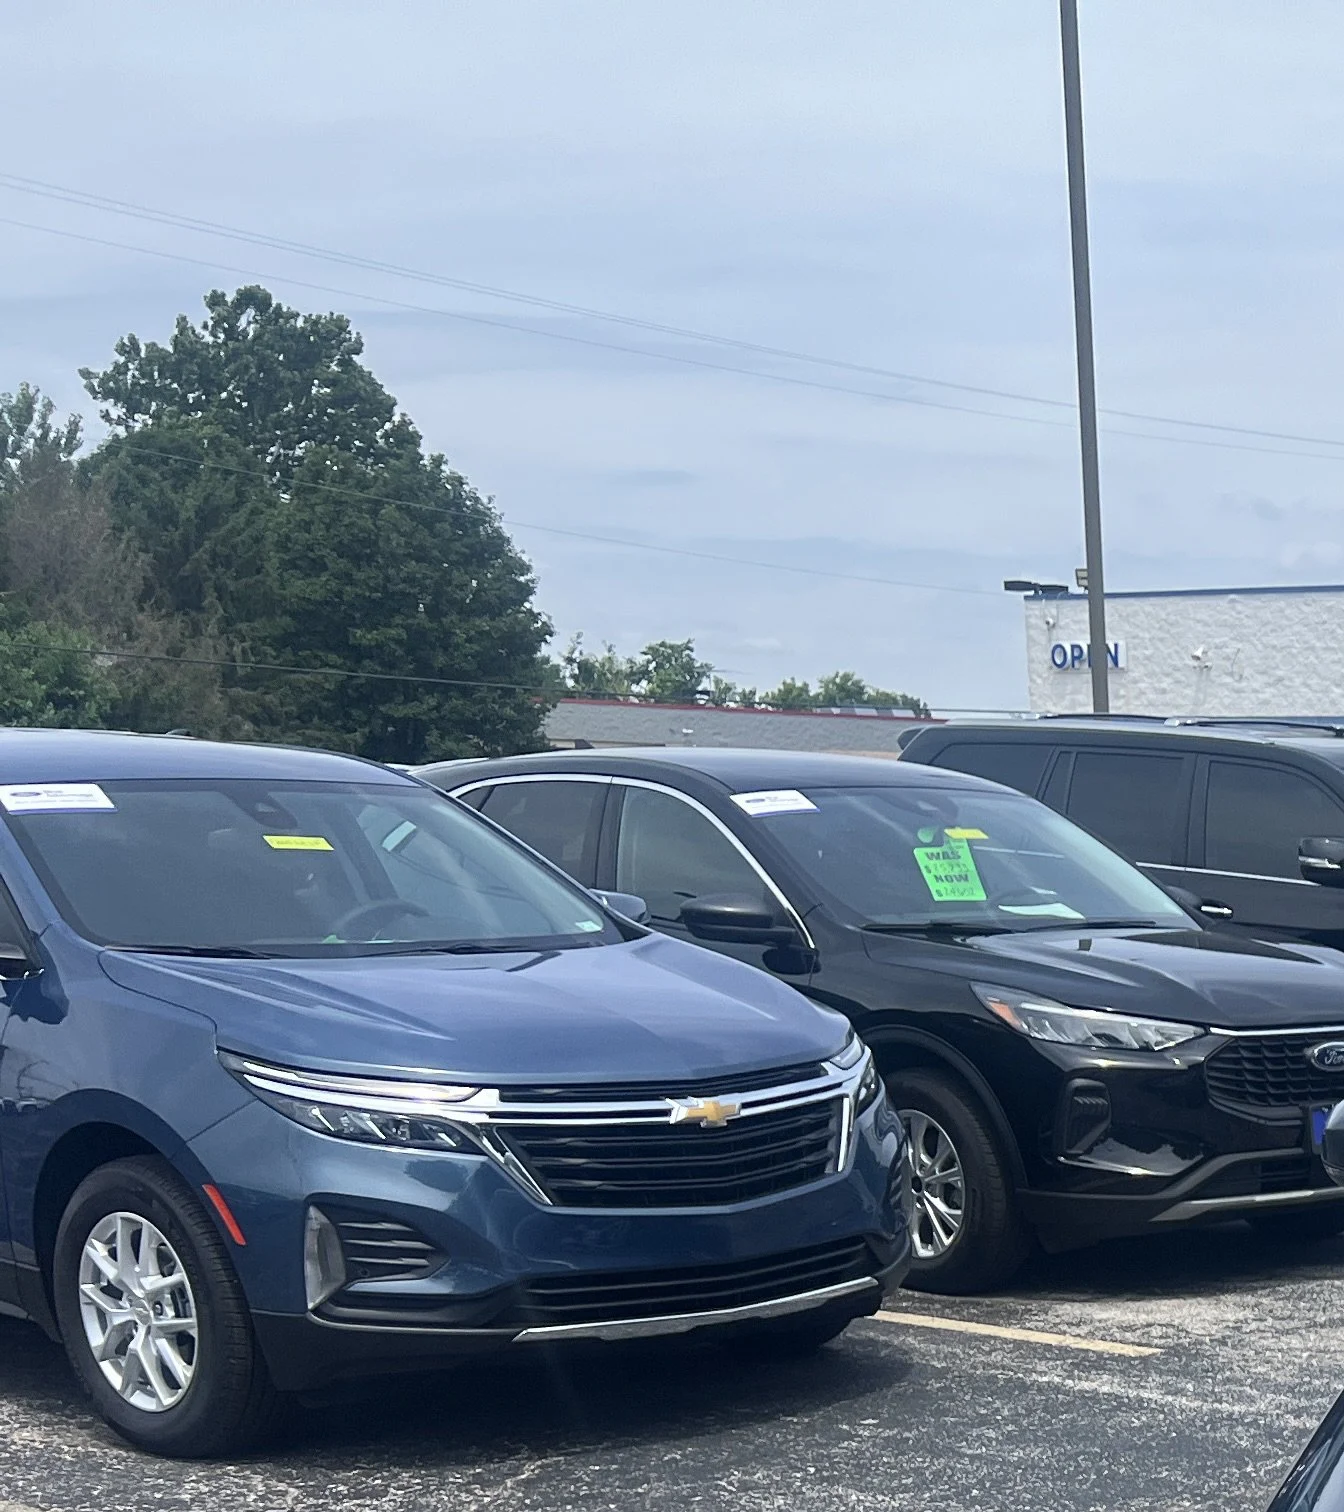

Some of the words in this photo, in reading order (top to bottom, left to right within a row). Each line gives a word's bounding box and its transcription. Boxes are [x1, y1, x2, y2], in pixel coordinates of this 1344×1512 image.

[1051, 643, 1119, 669] OPN
[924, 850, 962, 861] WAS
[933, 873, 970, 884] NOW
